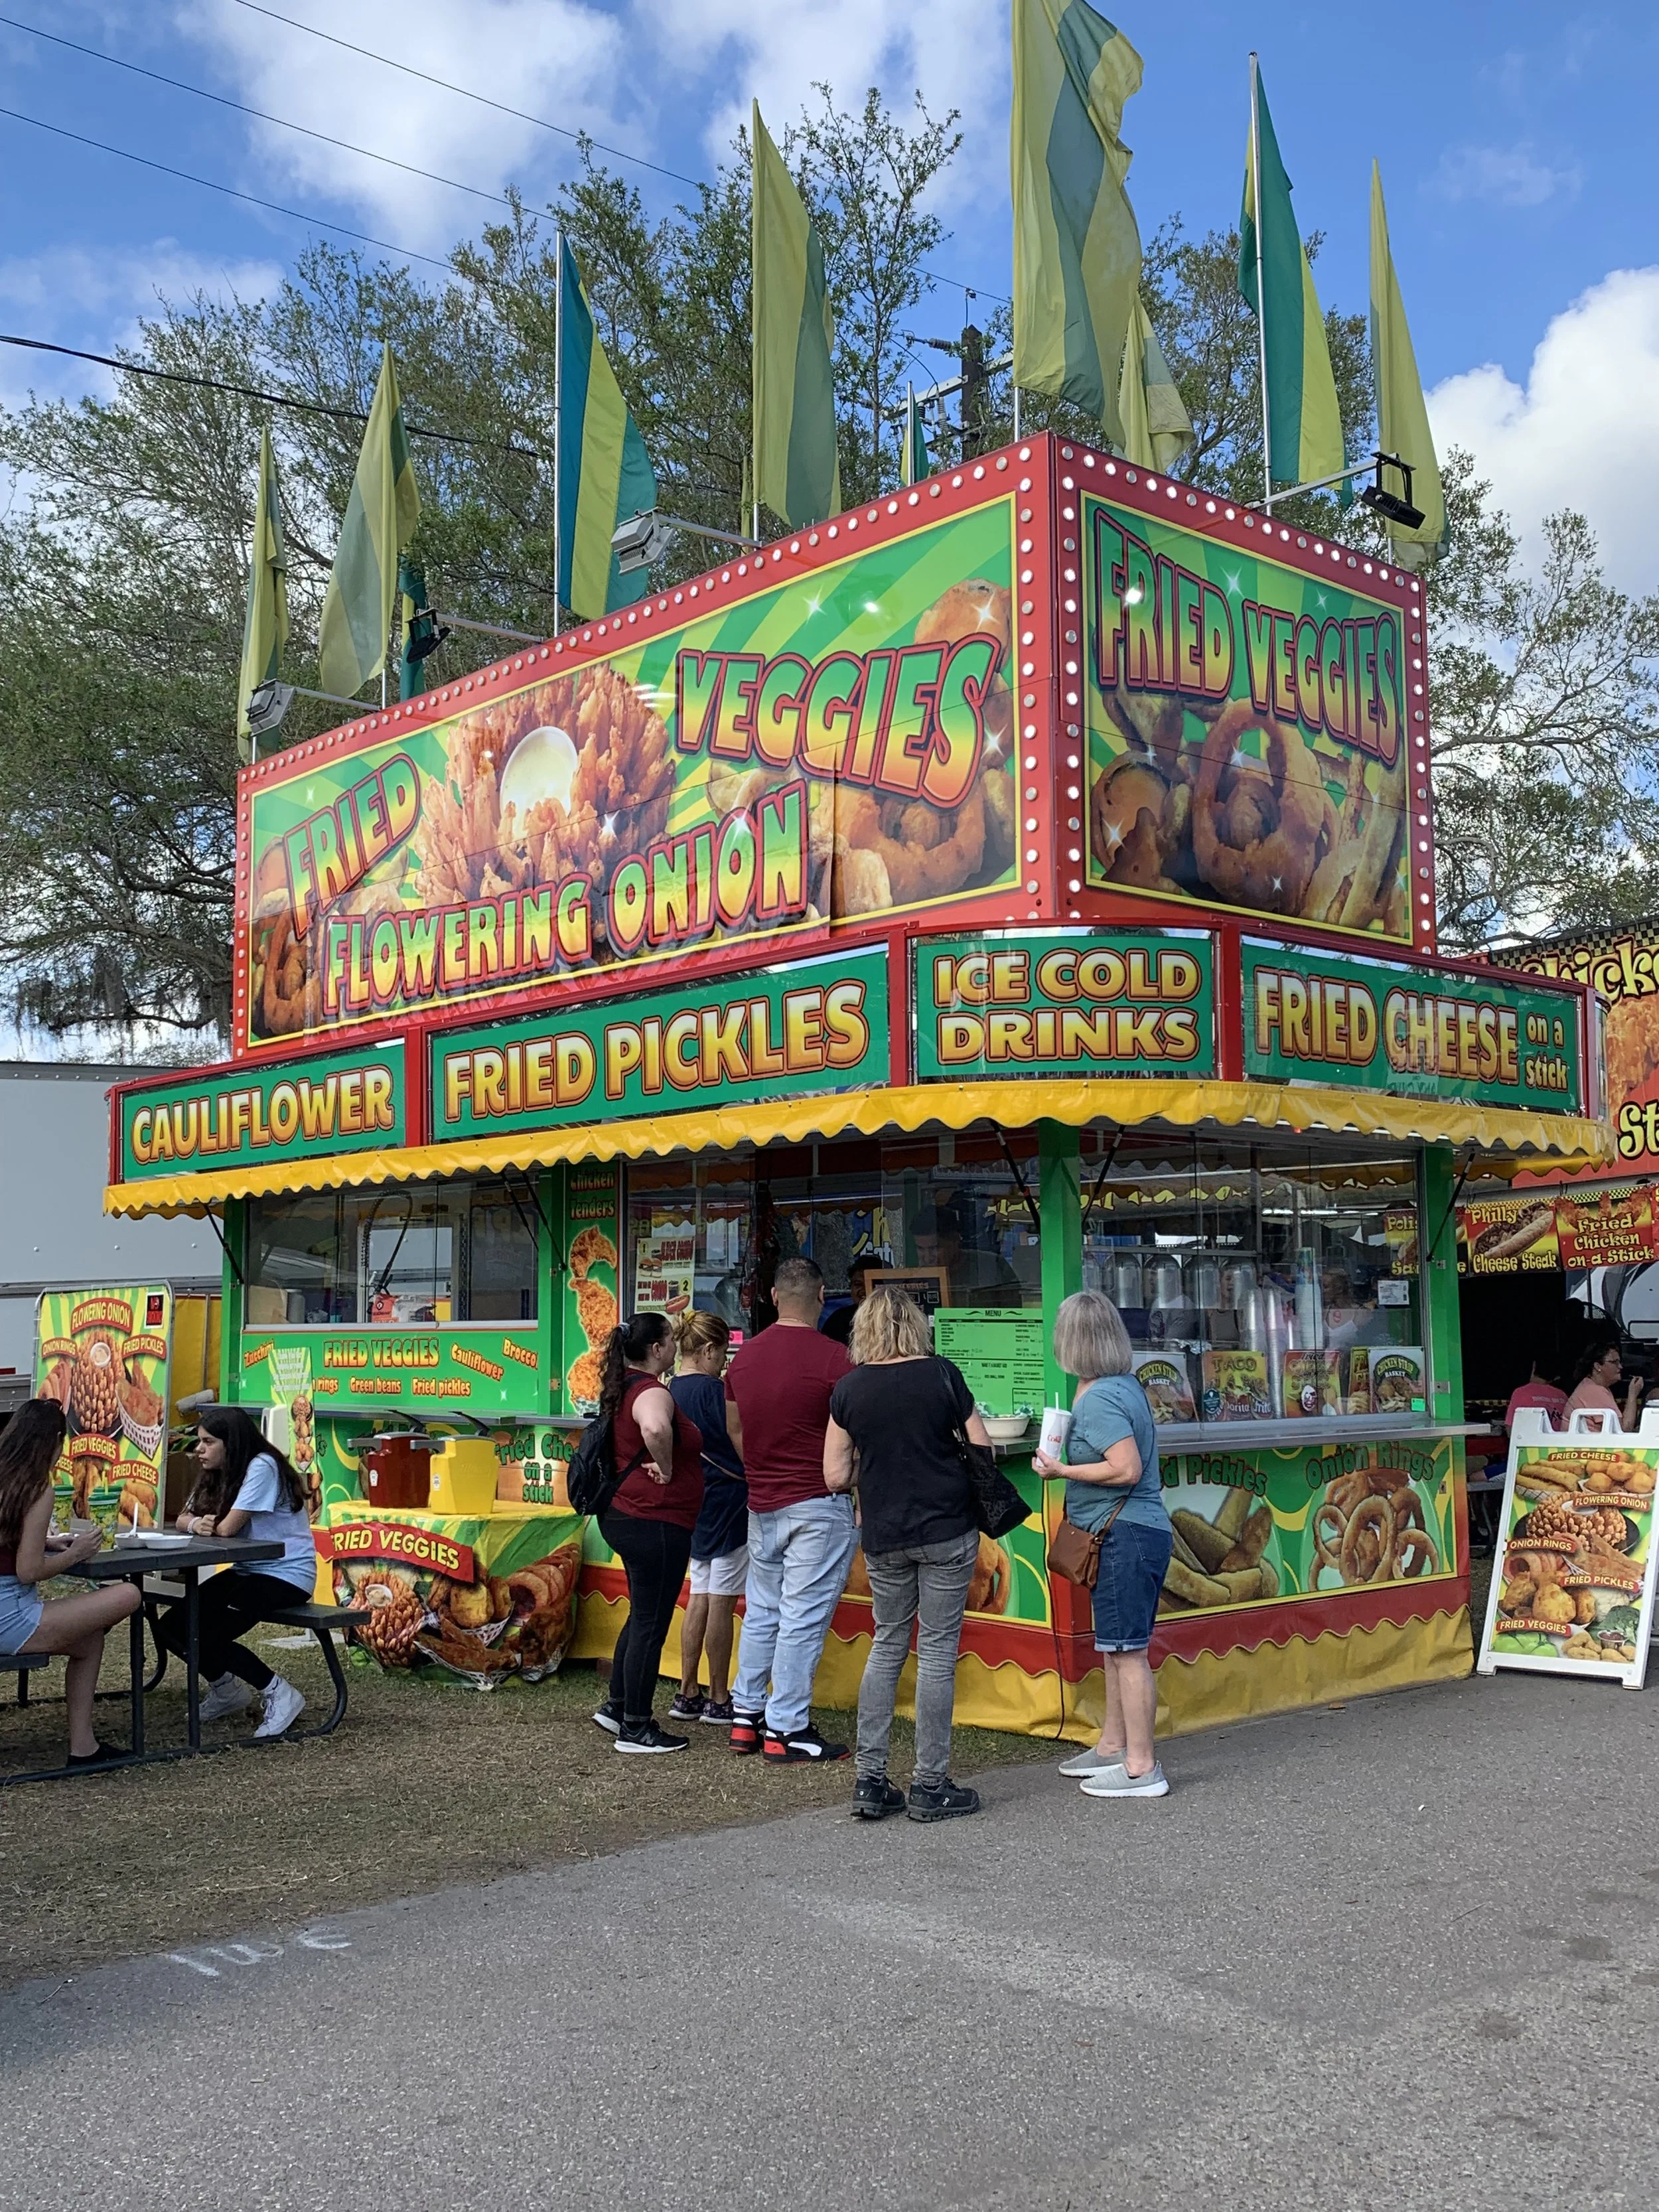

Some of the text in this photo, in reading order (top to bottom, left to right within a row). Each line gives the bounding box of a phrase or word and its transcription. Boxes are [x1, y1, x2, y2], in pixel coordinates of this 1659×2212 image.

[1095, 508, 1396, 768] FRIED VEGGIES
[283, 632, 1001, 938] FRIED VEGGIES
[323, 779, 808, 1016] FLOWERING ONION
[934, 948, 1200, 1007] ICE COLD
[936, 1008, 1199, 1065] DRINKS
[1254, 965, 1520, 1085] FRIED CHEESE
[1527, 1012, 1564, 1047] on a
[444, 979, 869, 1123] FRIED PICKLES
[1526, 1055, 1567, 1093] stick
[131, 1065, 395, 1165] CAULIFLOWER
[570, 1171, 614, 1191] Chicken
[569, 1197, 615, 1220] Tenders
[1471, 1206, 1519, 1225] Philly
[1577, 1213, 1634, 1233] Fried
[1574, 1232, 1640, 1250] Chicken
[1473, 1254, 1518, 1273] Cheese
[1522, 1250, 1557, 1270] Steak
[1567, 1246, 1654, 1268] on-a-Stick
[683, 1280, 689, 1291] 2
[72, 1301, 106, 1329] FLOWERING
[108, 1303, 131, 1328] ONION
[42, 1341, 60, 1355] ONION
[123, 1337, 164, 1355] FRIED PICKLES
[324, 1337, 439, 1368] FRIED VEGGIES
[451, 1342, 504, 1382] Cauliflower
[1211, 1356, 1257, 1372] TACO
[317, 1376, 339, 1395] rings
[350, 1376, 374, 1394] Green
[377, 1376, 402, 1394] beans
[412, 1378, 436, 1396] Fried
[439, 1378, 470, 1399] pickles
[71, 1436, 117, 1459] FRIED VEGGIES
[1551, 1452, 1617, 1462] FRIED CHEESE
[112, 1463, 157, 1485] FRIED CHEESE
[524, 1461, 552, 1482] on a
[1186, 1453, 1267, 1497] Pickles
[1306, 1445, 1370, 1489] Onion
[1376, 1441, 1434, 1481] Rings
[522, 1481, 553, 1505] stick
[1575, 1495, 1647, 1509] FLOWERING ONION
[331, 1529, 460, 1570] RIED VEGGIES
[1510, 1539, 1572, 1551] ONION RINGS
[1563, 1576, 1634, 1590] FRIED PICKLES
[1500, 1619, 1567, 1634] FRIED VEGGIES
